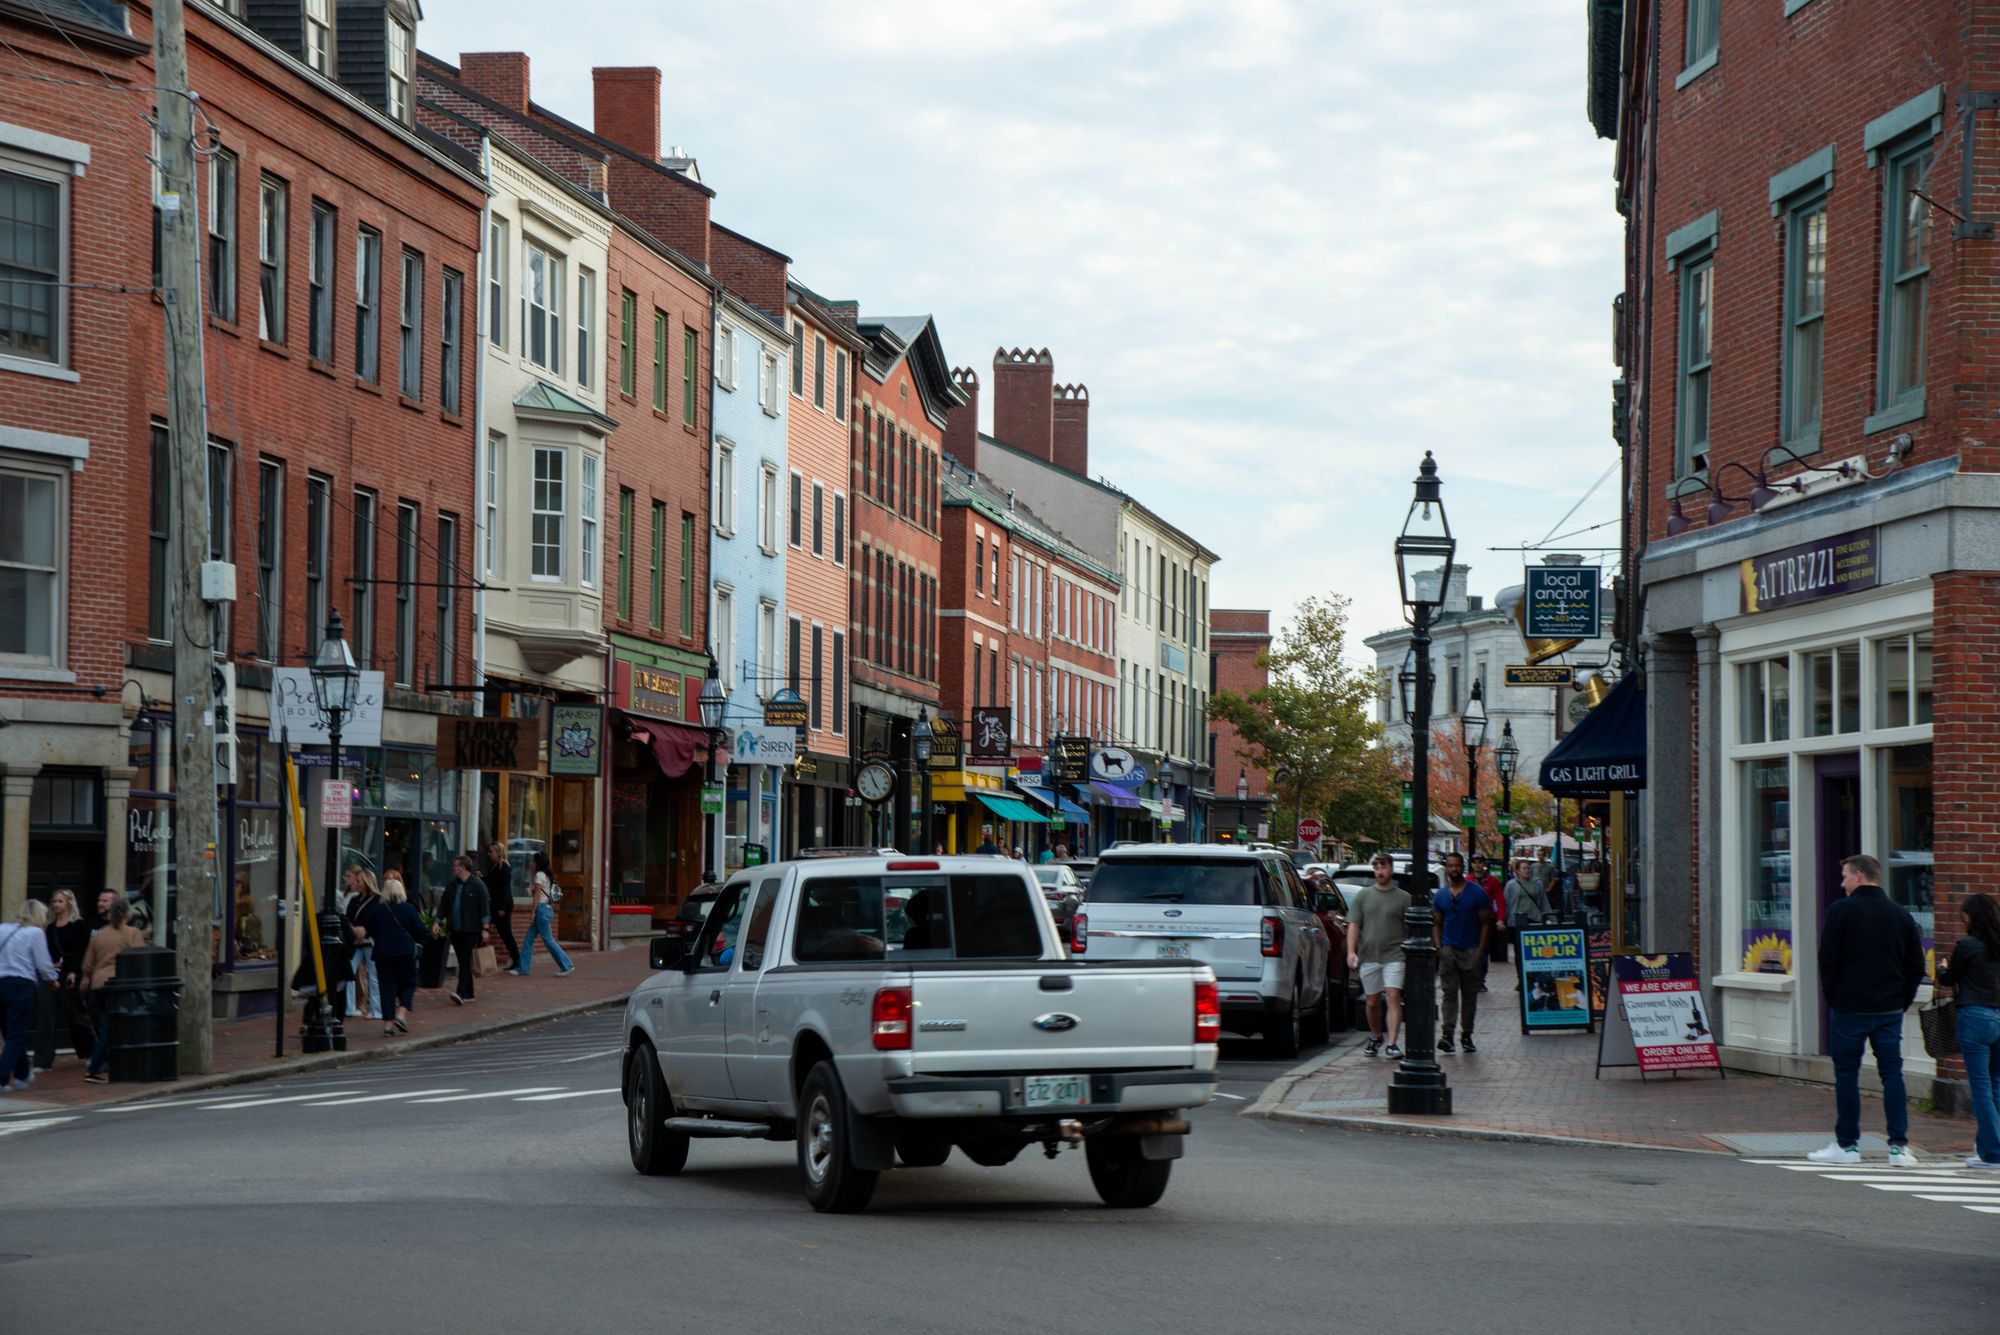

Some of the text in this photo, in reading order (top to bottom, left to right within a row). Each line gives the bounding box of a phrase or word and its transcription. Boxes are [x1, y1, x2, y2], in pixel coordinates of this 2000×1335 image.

[1543, 571, 1581, 587] local
[1759, 548, 1835, 600] ATTREZZI
[1535, 586, 1591, 600] anchor
[278, 676, 379, 708] Pree
[286, 707, 367, 719] BOUUE
[556, 709, 599, 720] GANESH
[455, 720, 519, 741] FLOWER
[455, 739, 519, 768] KIOSK
[760, 741, 794, 753] SIREN
[1023, 774, 1041, 783] RSG
[1549, 764, 1640, 782] GAS LIGHT GRILL
[129, 808, 174, 843] Prelude
[1299, 826, 1321, 836] STOP
[239, 817, 274, 850] Prelude
[1524, 933, 1581, 946] HAPPY
[1531, 945, 1577, 958] HOUR
[1625, 981, 1693, 993] WE ARE OPEN!!
[1655, 1010, 1671, 1022] beer
[1643, 1044, 1711, 1057] ORDER ONLINE
